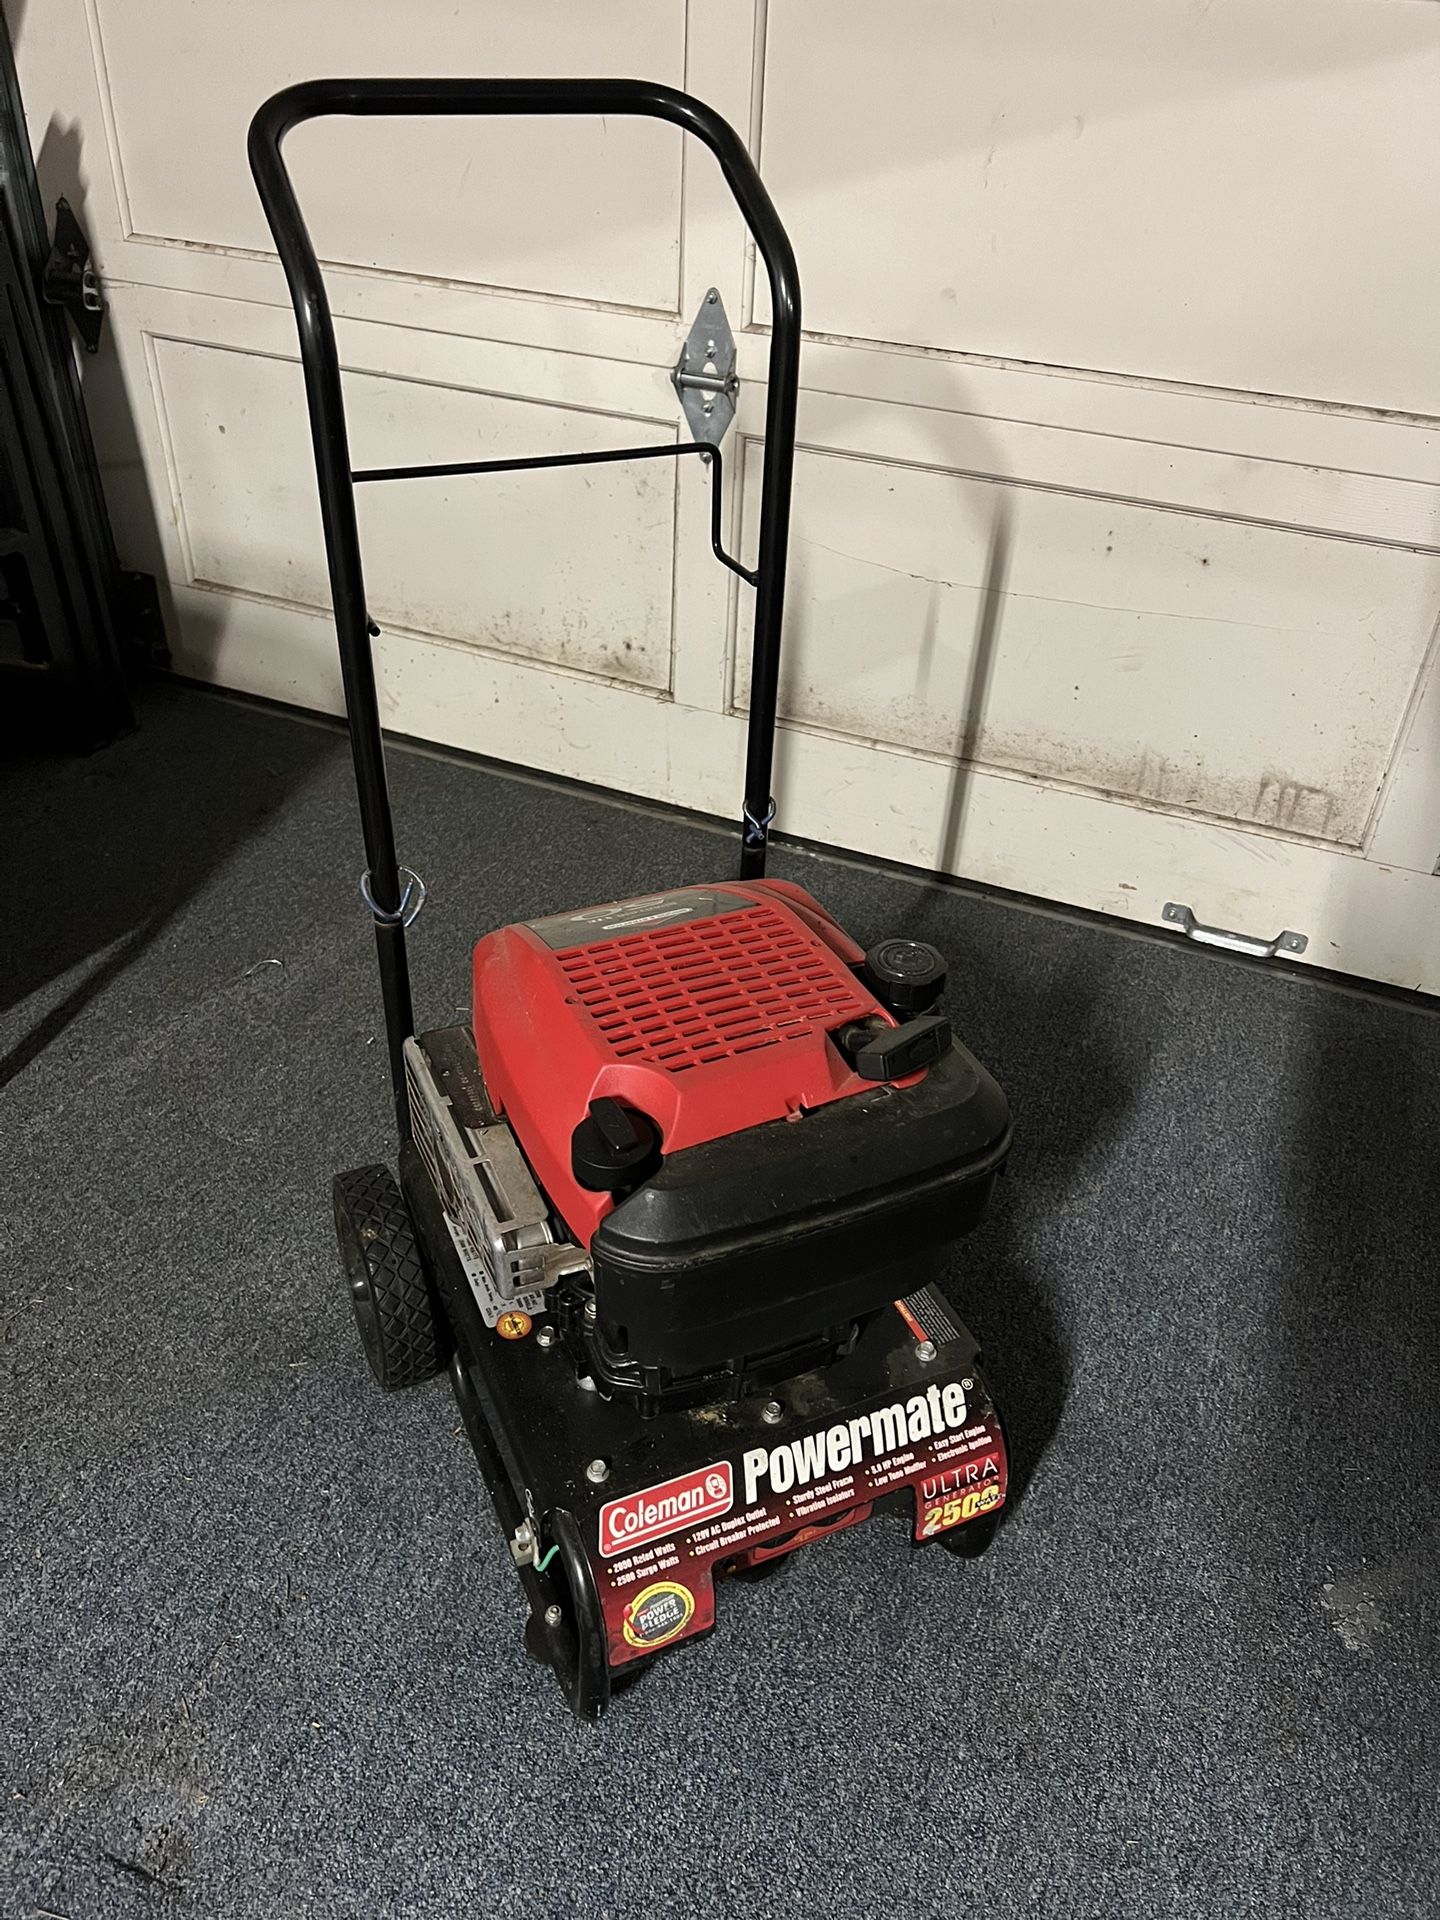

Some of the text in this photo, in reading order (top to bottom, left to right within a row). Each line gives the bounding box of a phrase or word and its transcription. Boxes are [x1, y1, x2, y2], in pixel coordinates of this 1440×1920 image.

[933, 1438, 949, 1450] Easy
[892, 1452, 915, 1467] Engine
[792, 1475, 854, 1505] Sturdy Steel Frame
[874, 1475, 889, 1487] Low
[923, 1457, 998, 1500] ULTRA
[608, 1486, 705, 1538] Coleman
[795, 1488, 855, 1517] Vibration Isolators
[692, 1506, 767, 1543] 120V AC Duplex Outlet
[695, 1540, 720, 1556] Circuit
[718, 1529, 747, 1547] Breaker
[746, 1515, 781, 1536] Protected
[654, 1542, 676, 1555] Watts
[636, 1563, 659, 1579] Surge
[658, 1555, 680, 1570] Watts
[639, 1598, 677, 1625] POWER
[641, 1607, 680, 1632] PLEDGE
